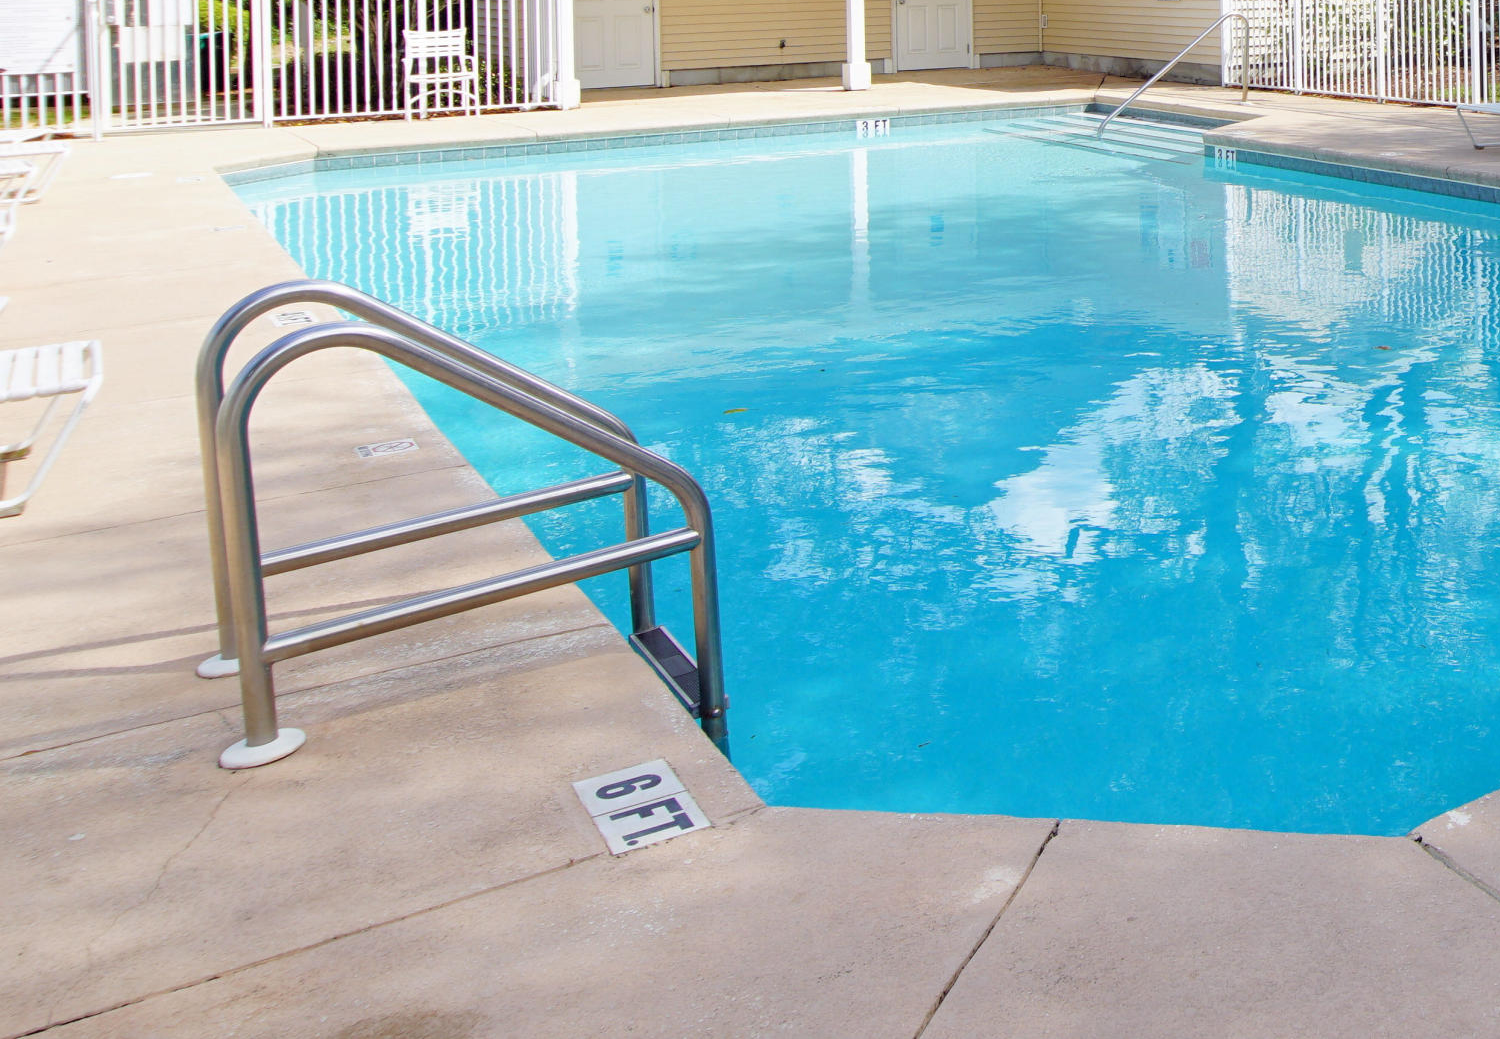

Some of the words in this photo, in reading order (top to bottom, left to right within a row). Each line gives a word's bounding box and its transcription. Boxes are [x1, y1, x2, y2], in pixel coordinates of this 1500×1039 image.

[874, 119, 888, 130] FT
[1225, 149, 1235, 161] FT
[595, 773, 663, 800] 6
[608, 797, 696, 847] FT.
